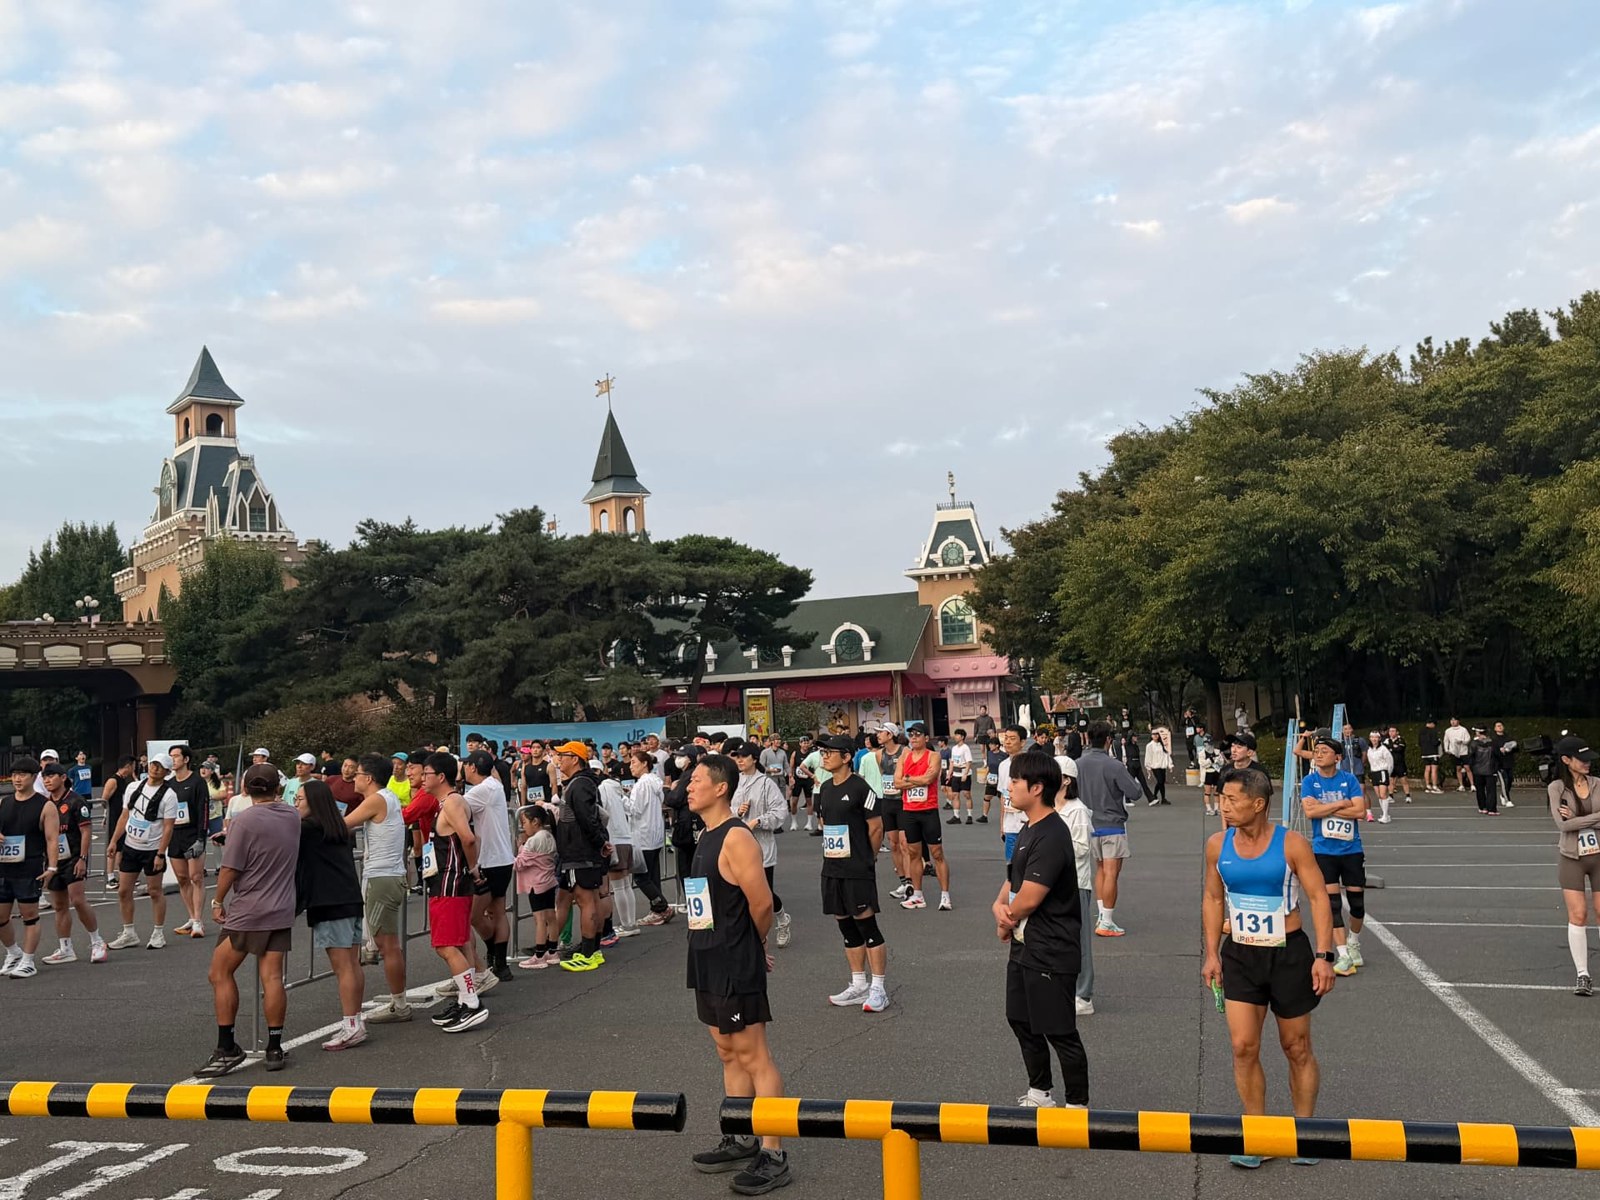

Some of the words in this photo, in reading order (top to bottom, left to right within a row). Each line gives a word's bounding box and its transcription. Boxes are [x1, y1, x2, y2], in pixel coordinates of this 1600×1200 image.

[908, 788, 925, 798] 026
[128, 825, 145, 838] 017
[1327, 819, 1352, 834] 079
[1577, 834, 1596, 847] 16
[687, 897, 704, 917] 19
[1235, 912, 1274, 934] 131
[463, 973, 475, 994] DRC
